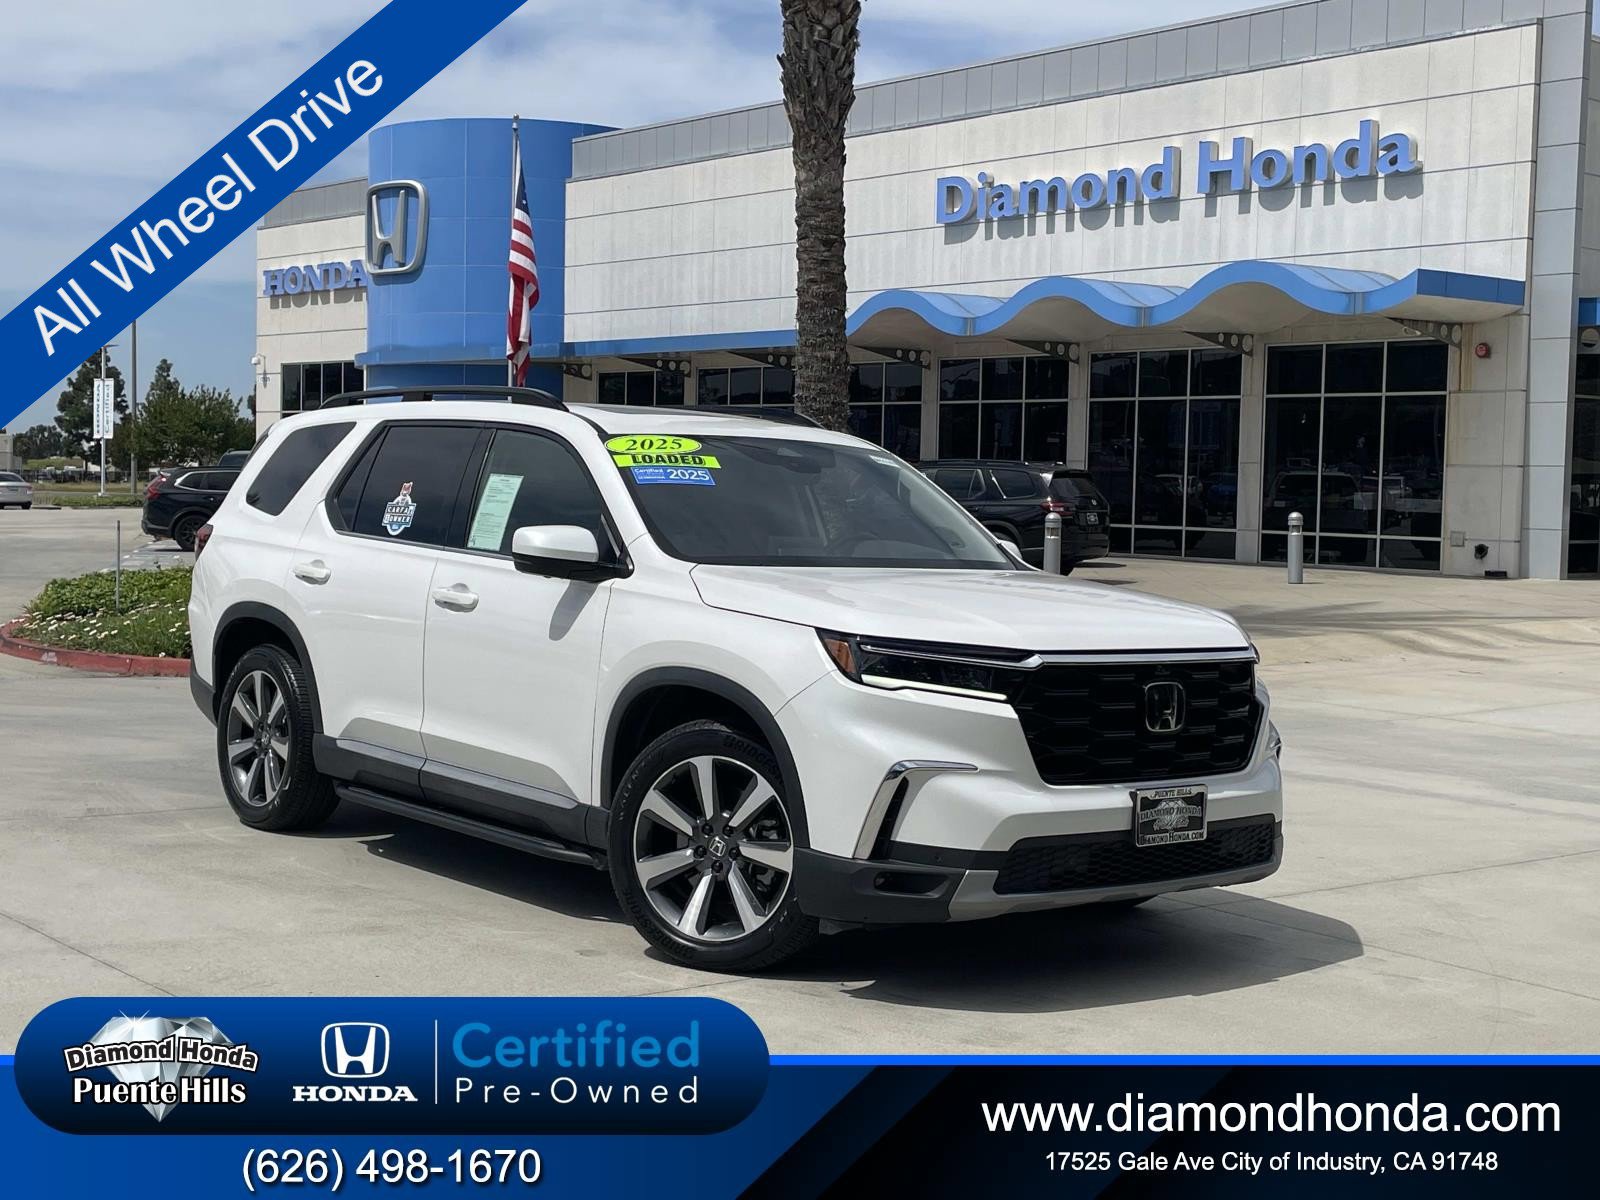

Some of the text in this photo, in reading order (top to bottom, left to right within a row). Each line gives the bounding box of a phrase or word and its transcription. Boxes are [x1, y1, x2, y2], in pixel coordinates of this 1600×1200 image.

[936, 119, 1423, 224] Diamond Honda
[263, 260, 367, 296] HONDA
[625, 438, 682, 450] 2025
[632, 454, 705, 466] LOADED
[667, 469, 710, 481] 2025
[387, 505, 413, 514] CARFA
[1154, 788, 1192, 798] PUENTE HILLS
[1140, 806, 1202, 821] DIAMOND HONDA
